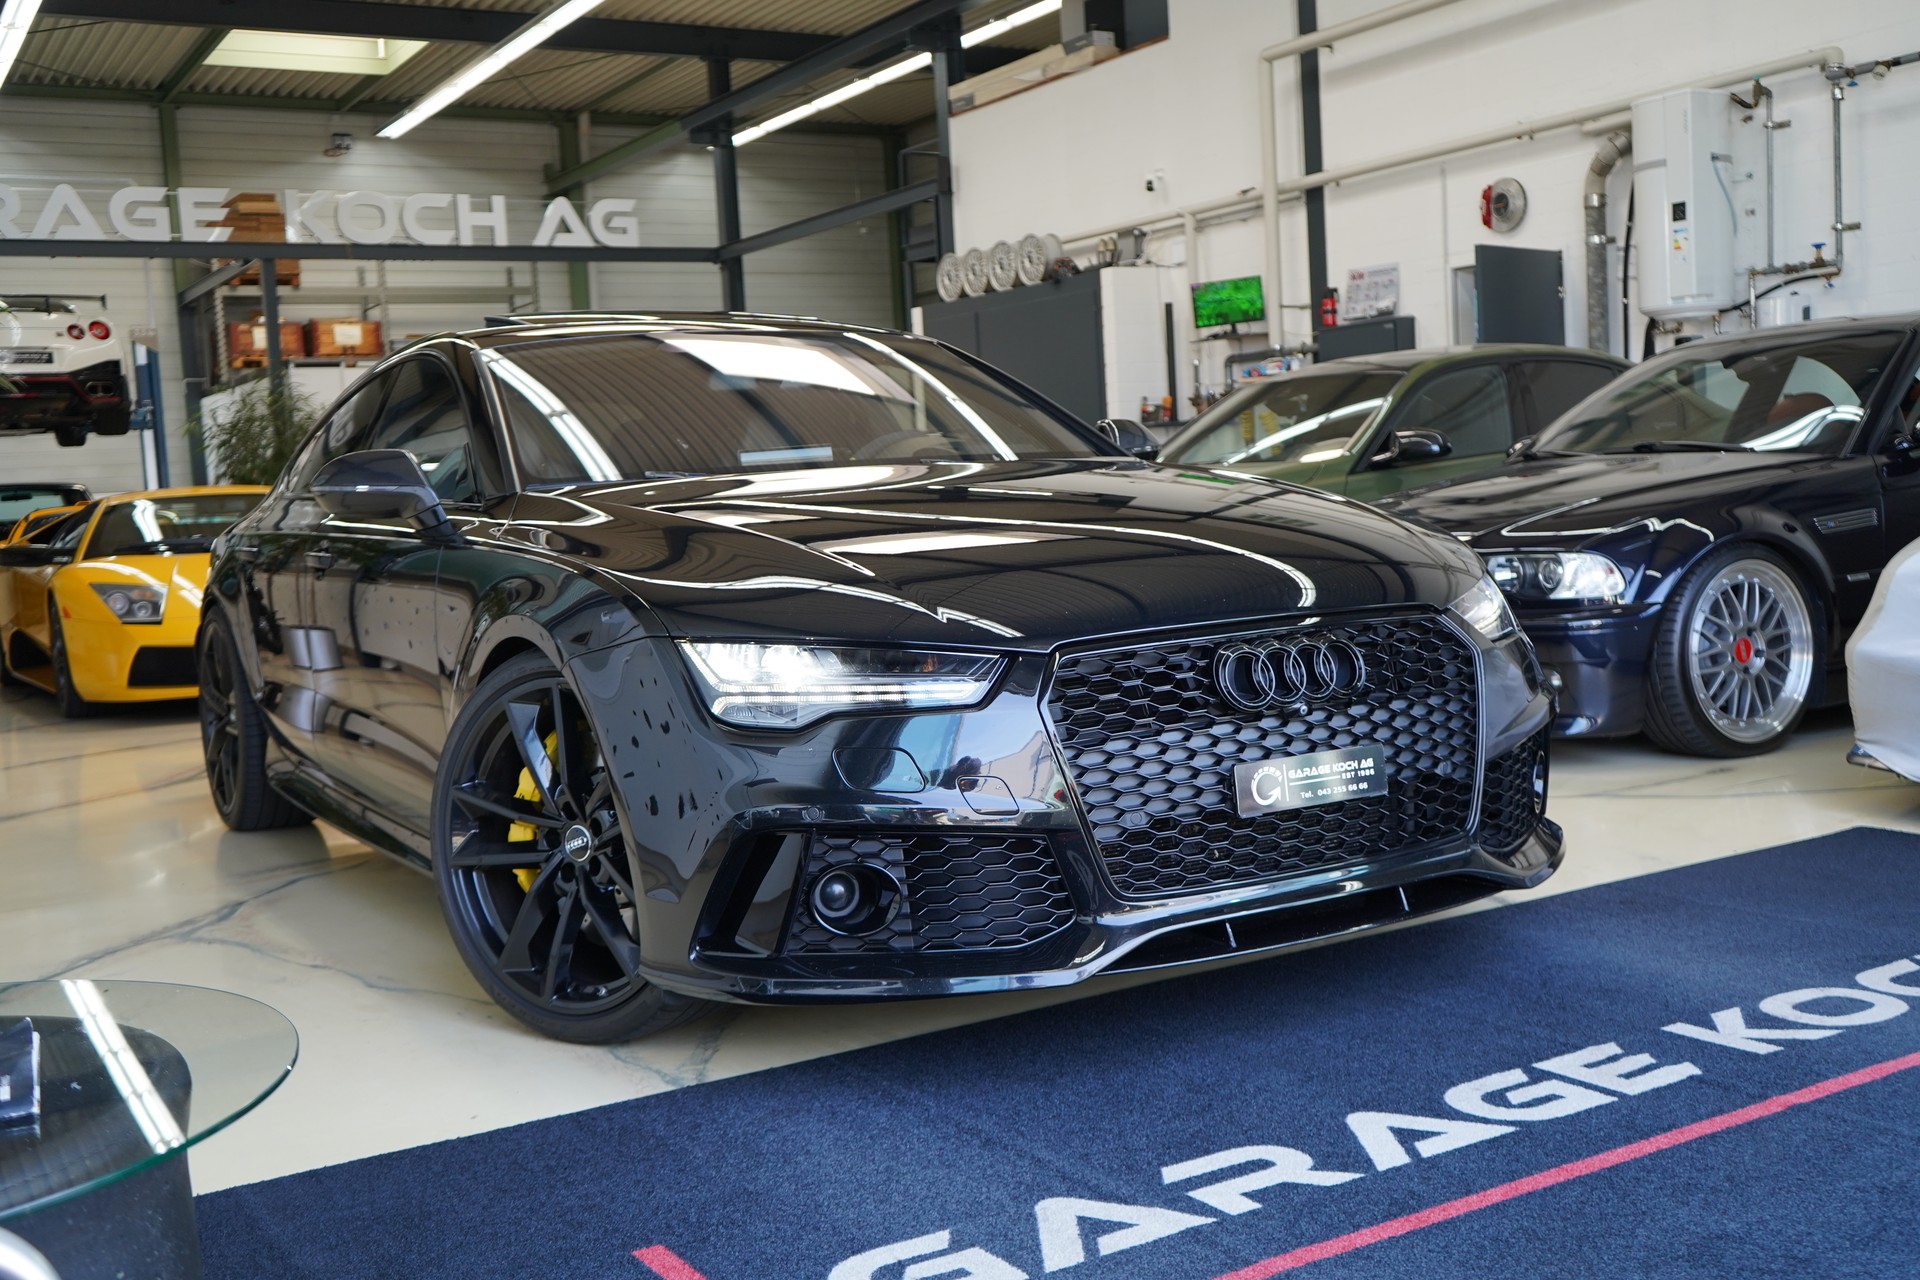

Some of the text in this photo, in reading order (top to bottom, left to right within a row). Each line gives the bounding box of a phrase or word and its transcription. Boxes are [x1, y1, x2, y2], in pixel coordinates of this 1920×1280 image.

[285, 189, 508, 246] KOCH
[531, 196, 640, 248] AG
[1288, 758, 1374, 779] GARAGE KOCH AG
[1300, 781, 1368, 799] Tel. 043 255 66 66
